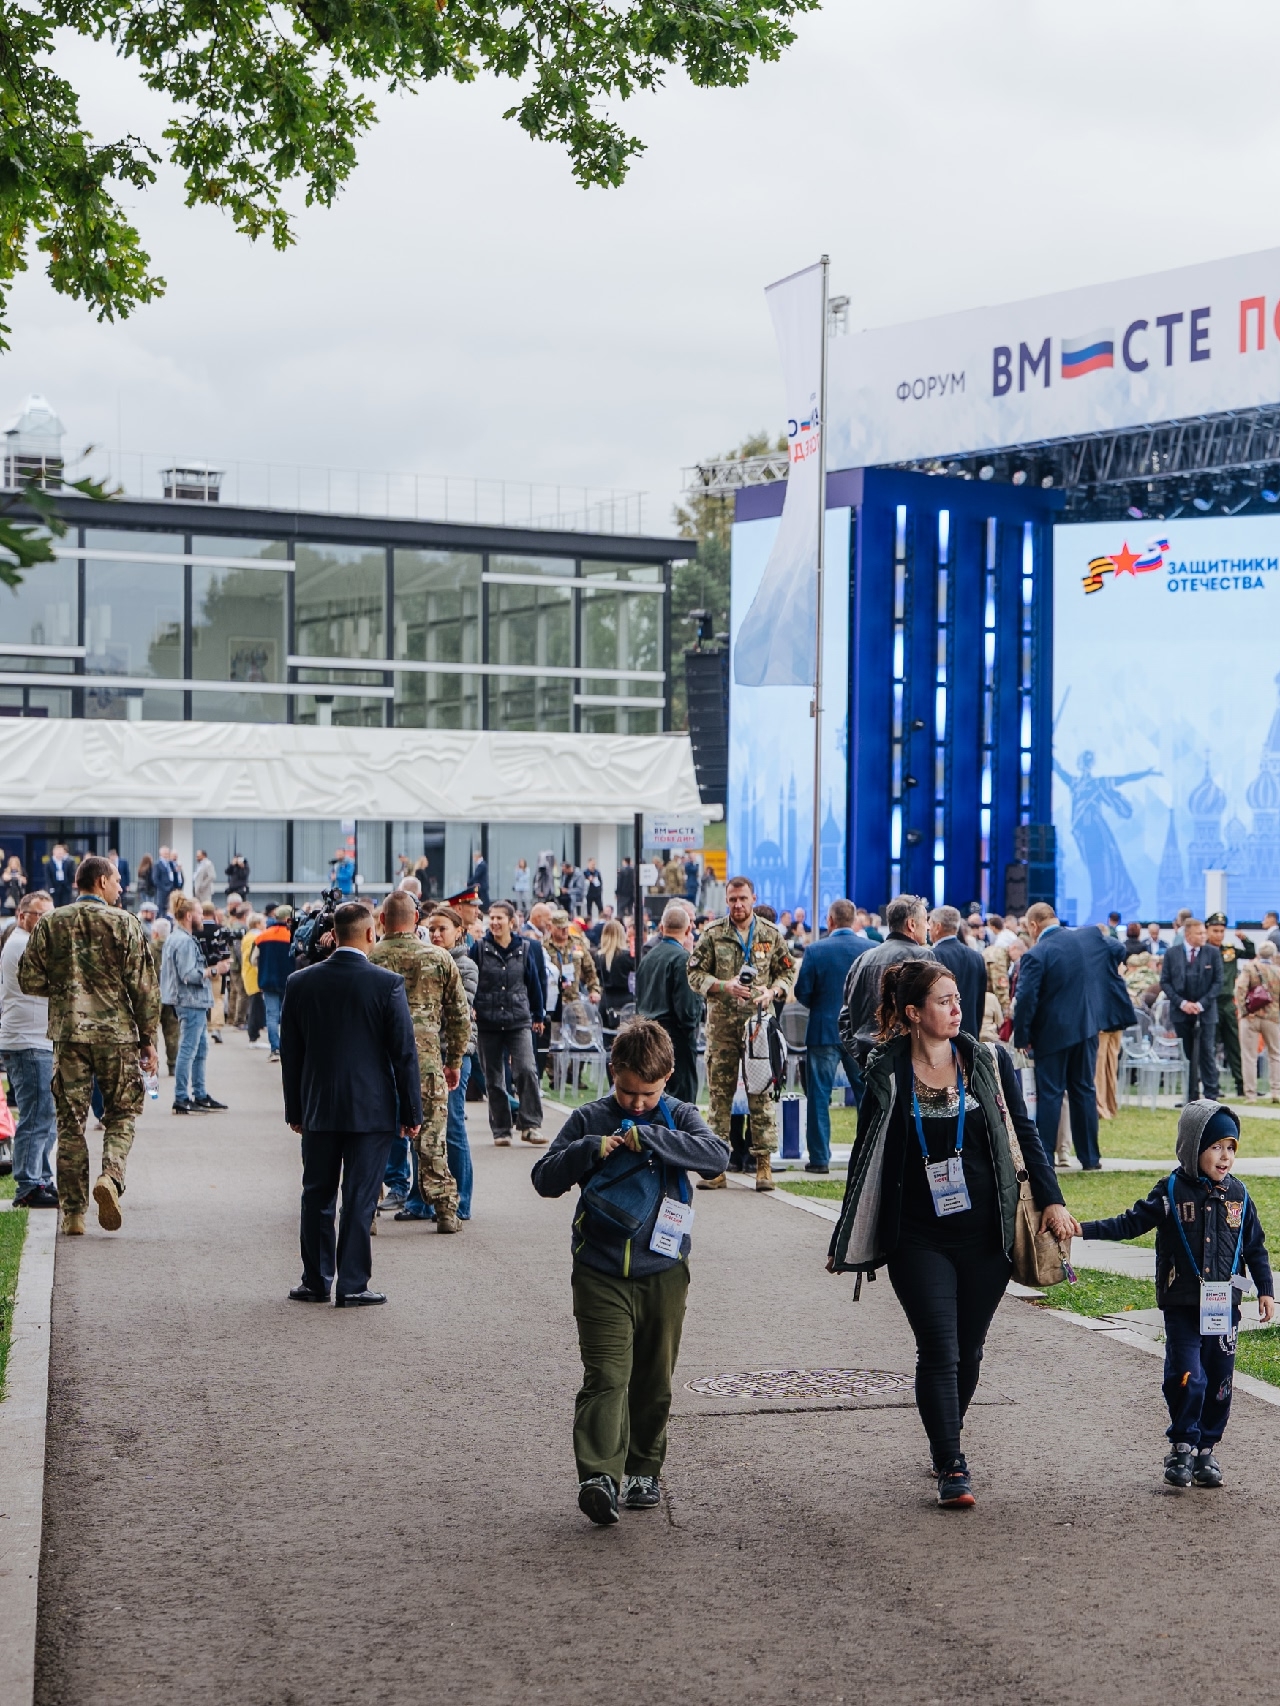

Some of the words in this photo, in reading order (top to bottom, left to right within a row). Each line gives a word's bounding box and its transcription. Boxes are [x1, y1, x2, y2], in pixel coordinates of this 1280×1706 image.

[896, 370, 966, 402] ФОРУМ
[992, 305, 1212, 397] ВМСТЕ
[1168, 557, 1279, 577] ЗАЩИТНИКИ
[1167, 575, 1265, 593] ОТЕЧЕСТВА
